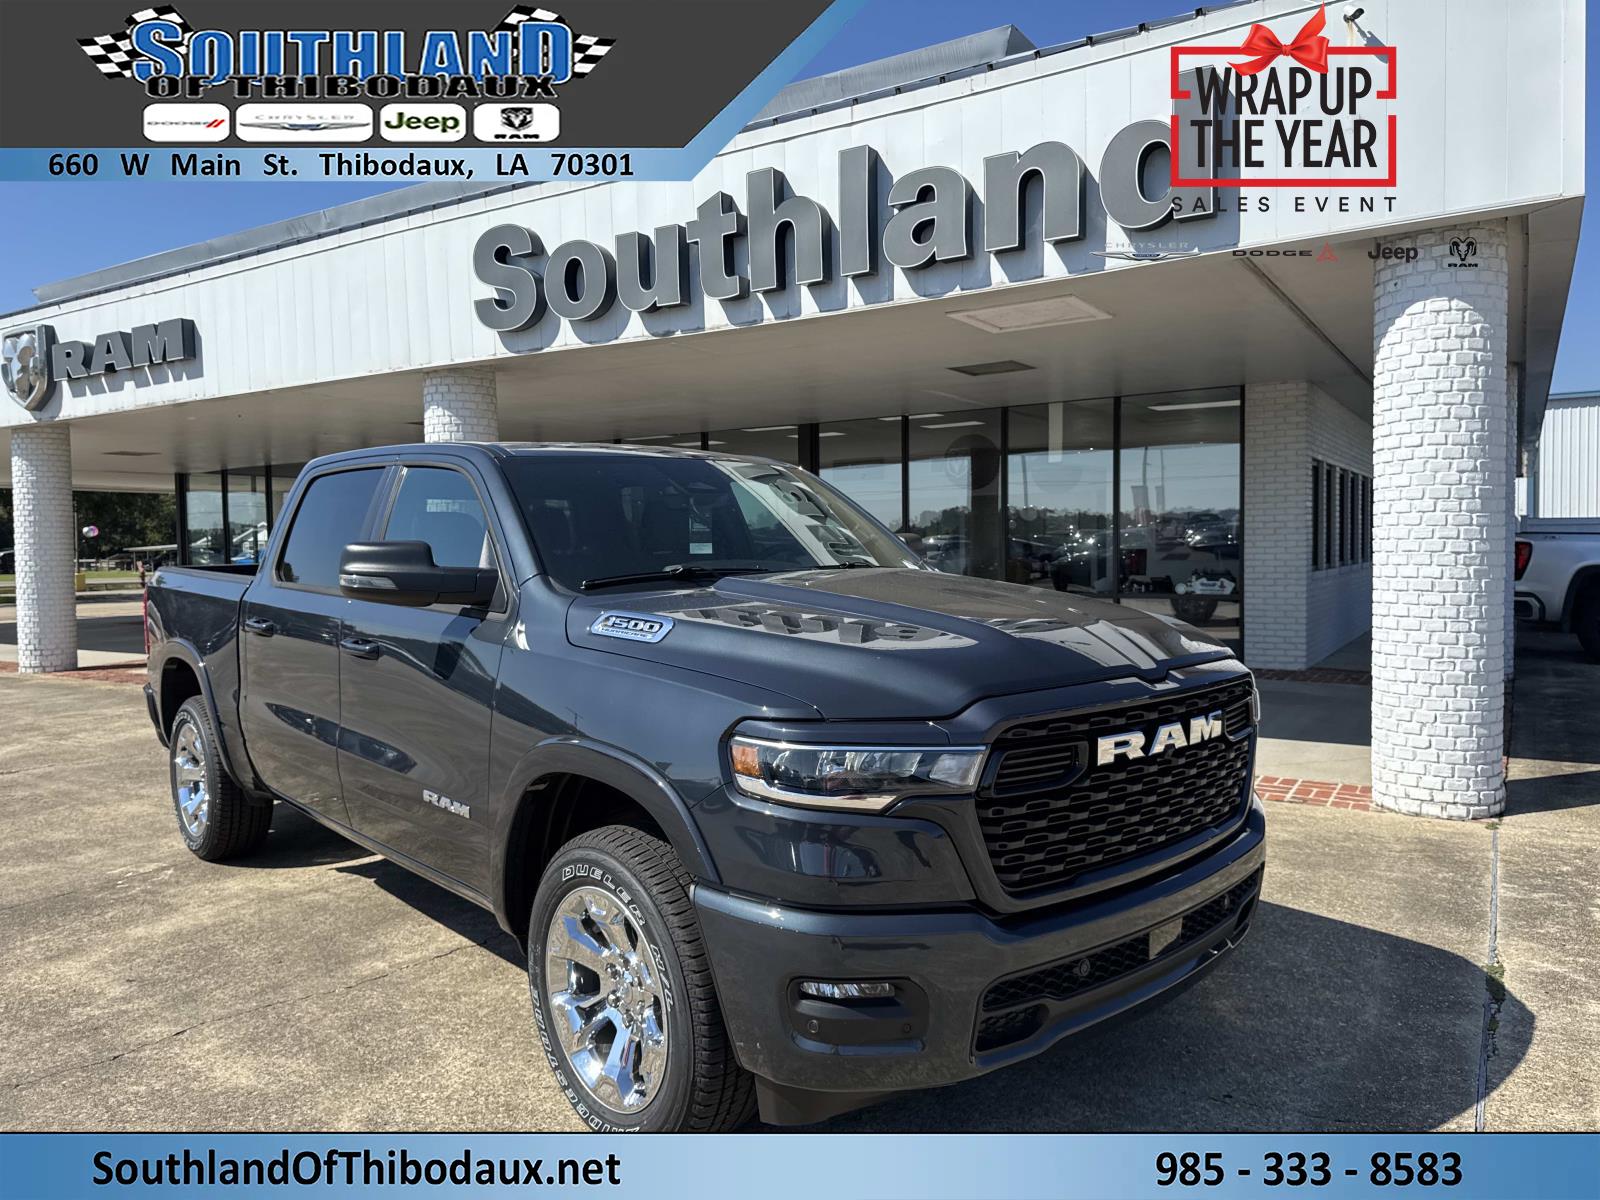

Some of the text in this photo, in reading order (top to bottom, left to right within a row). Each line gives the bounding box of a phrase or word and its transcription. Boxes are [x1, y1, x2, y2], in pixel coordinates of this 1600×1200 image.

[473, 64, 1217, 333] Southland
[52, 317, 196, 382] RAM
[606, 616, 661, 633] 1500
[1097, 709, 1222, 766] RAM
[422, 788, 470, 819] RAM
[562, 864, 646, 926] DUELER
